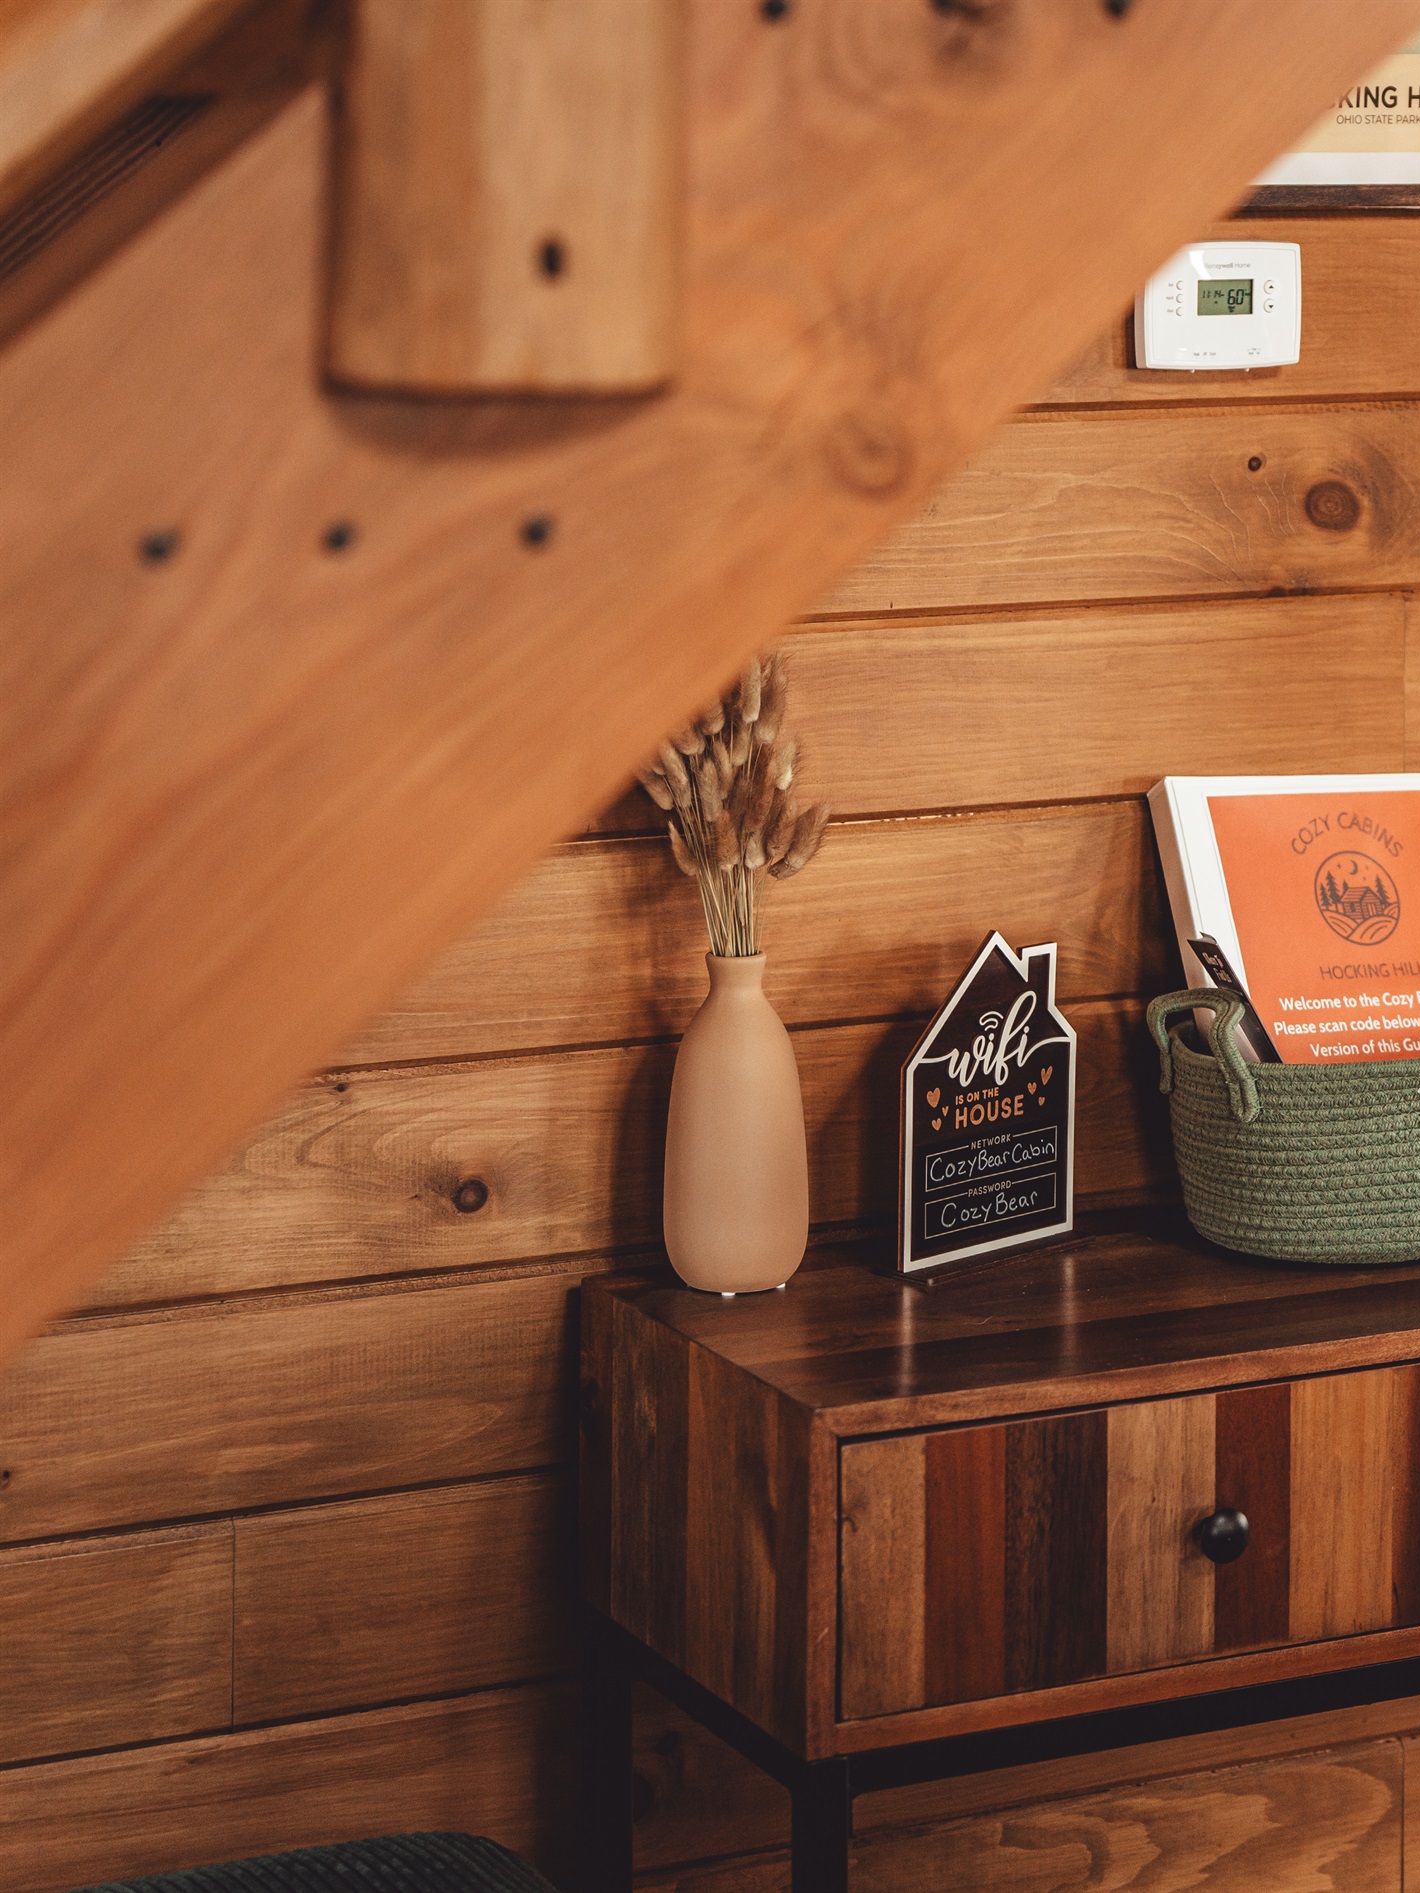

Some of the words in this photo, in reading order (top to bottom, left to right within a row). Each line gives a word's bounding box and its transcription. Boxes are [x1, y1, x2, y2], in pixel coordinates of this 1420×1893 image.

[1331, 85, 1398, 109] KING
[1336, 114, 1363, 125] OHIO
[1364, 114, 1393, 125] STATE
[1227, 288, 1245, 305] 60
[1291, 813, 1330, 855] COZY
[1337, 811, 1403, 857] CABINS
[1319, 963, 1390, 981] HOCKING
[1279, 995, 1342, 1011] Welcome
[1343, 996, 1358, 1008] to
[1359, 993, 1381, 1008] the
[1382, 991, 1414, 1010] Cozy
[1273, 1020, 1317, 1036] Please
[1318, 1020, 1349, 1033] scan
[1350, 1015, 1382, 1031] code
[936, 989, 1045, 1088] wifi
[1310, 1041, 1361, 1058] Version
[1362, 1039, 1376, 1055] of
[1377, 1037, 1401, 1054] this
[955, 1094, 964, 1106] IS
[966, 1091, 981, 1104] ON
[982, 1086, 1000, 1101] THE
[955, 1093, 1025, 1131] HOUSE
[970, 1133, 1012, 1150] NETWORK
[929, 1139, 1055, 1183] CozyBearCabin
[968, 1180, 1012, 1198] PASSWORD
[940, 1190, 1038, 1229] CozyBear
